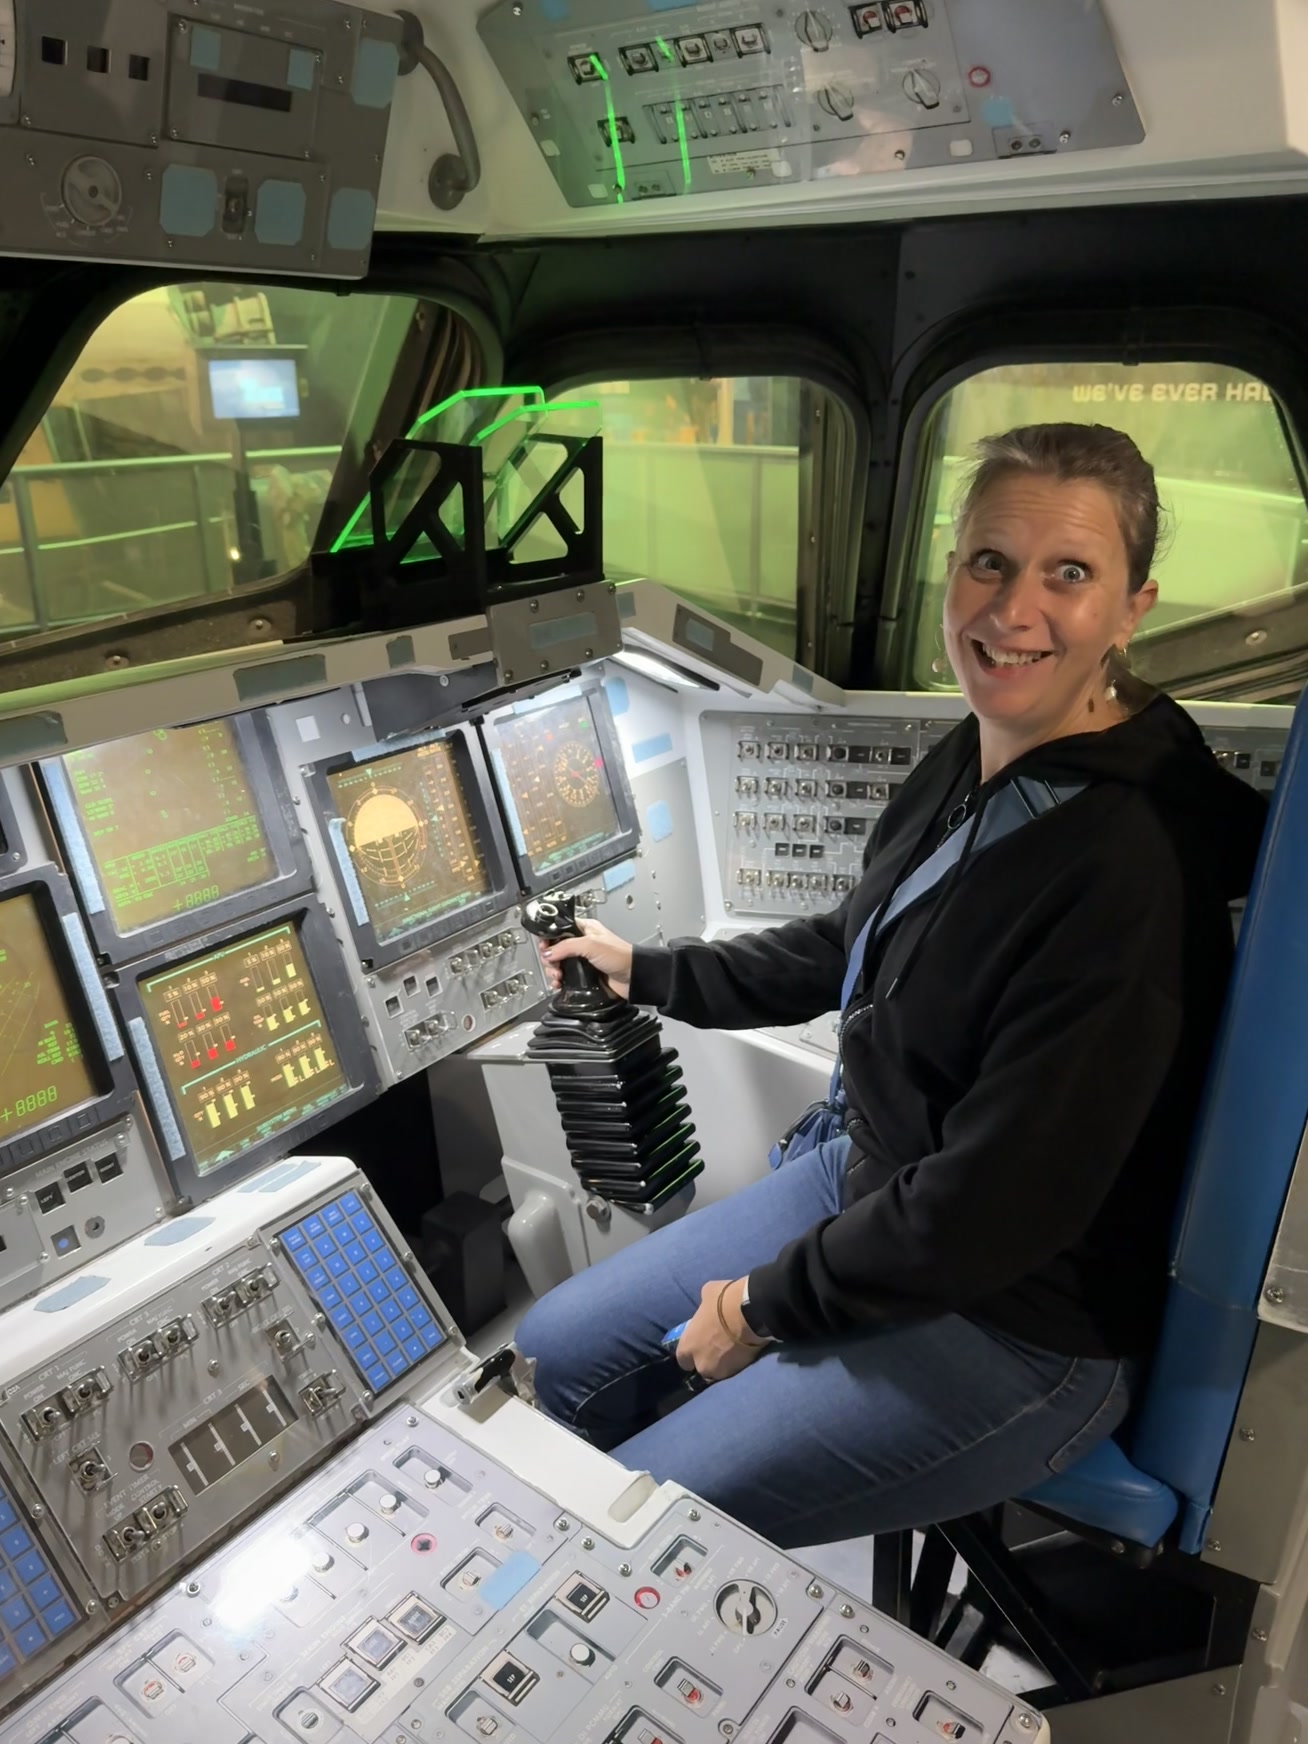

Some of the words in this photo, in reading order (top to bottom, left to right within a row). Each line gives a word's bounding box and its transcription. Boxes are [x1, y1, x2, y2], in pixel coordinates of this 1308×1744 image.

[1072, 383, 1144, 402] WE'VE
[1151, 382, 1218, 402] EVER
[235, 1044, 267, 1063] HYDRAULIC
[38, 1367, 54, 1381] CRT
[579, 1593, 590, 1603] SEP
[506, 1673, 517, 1684] SEP
